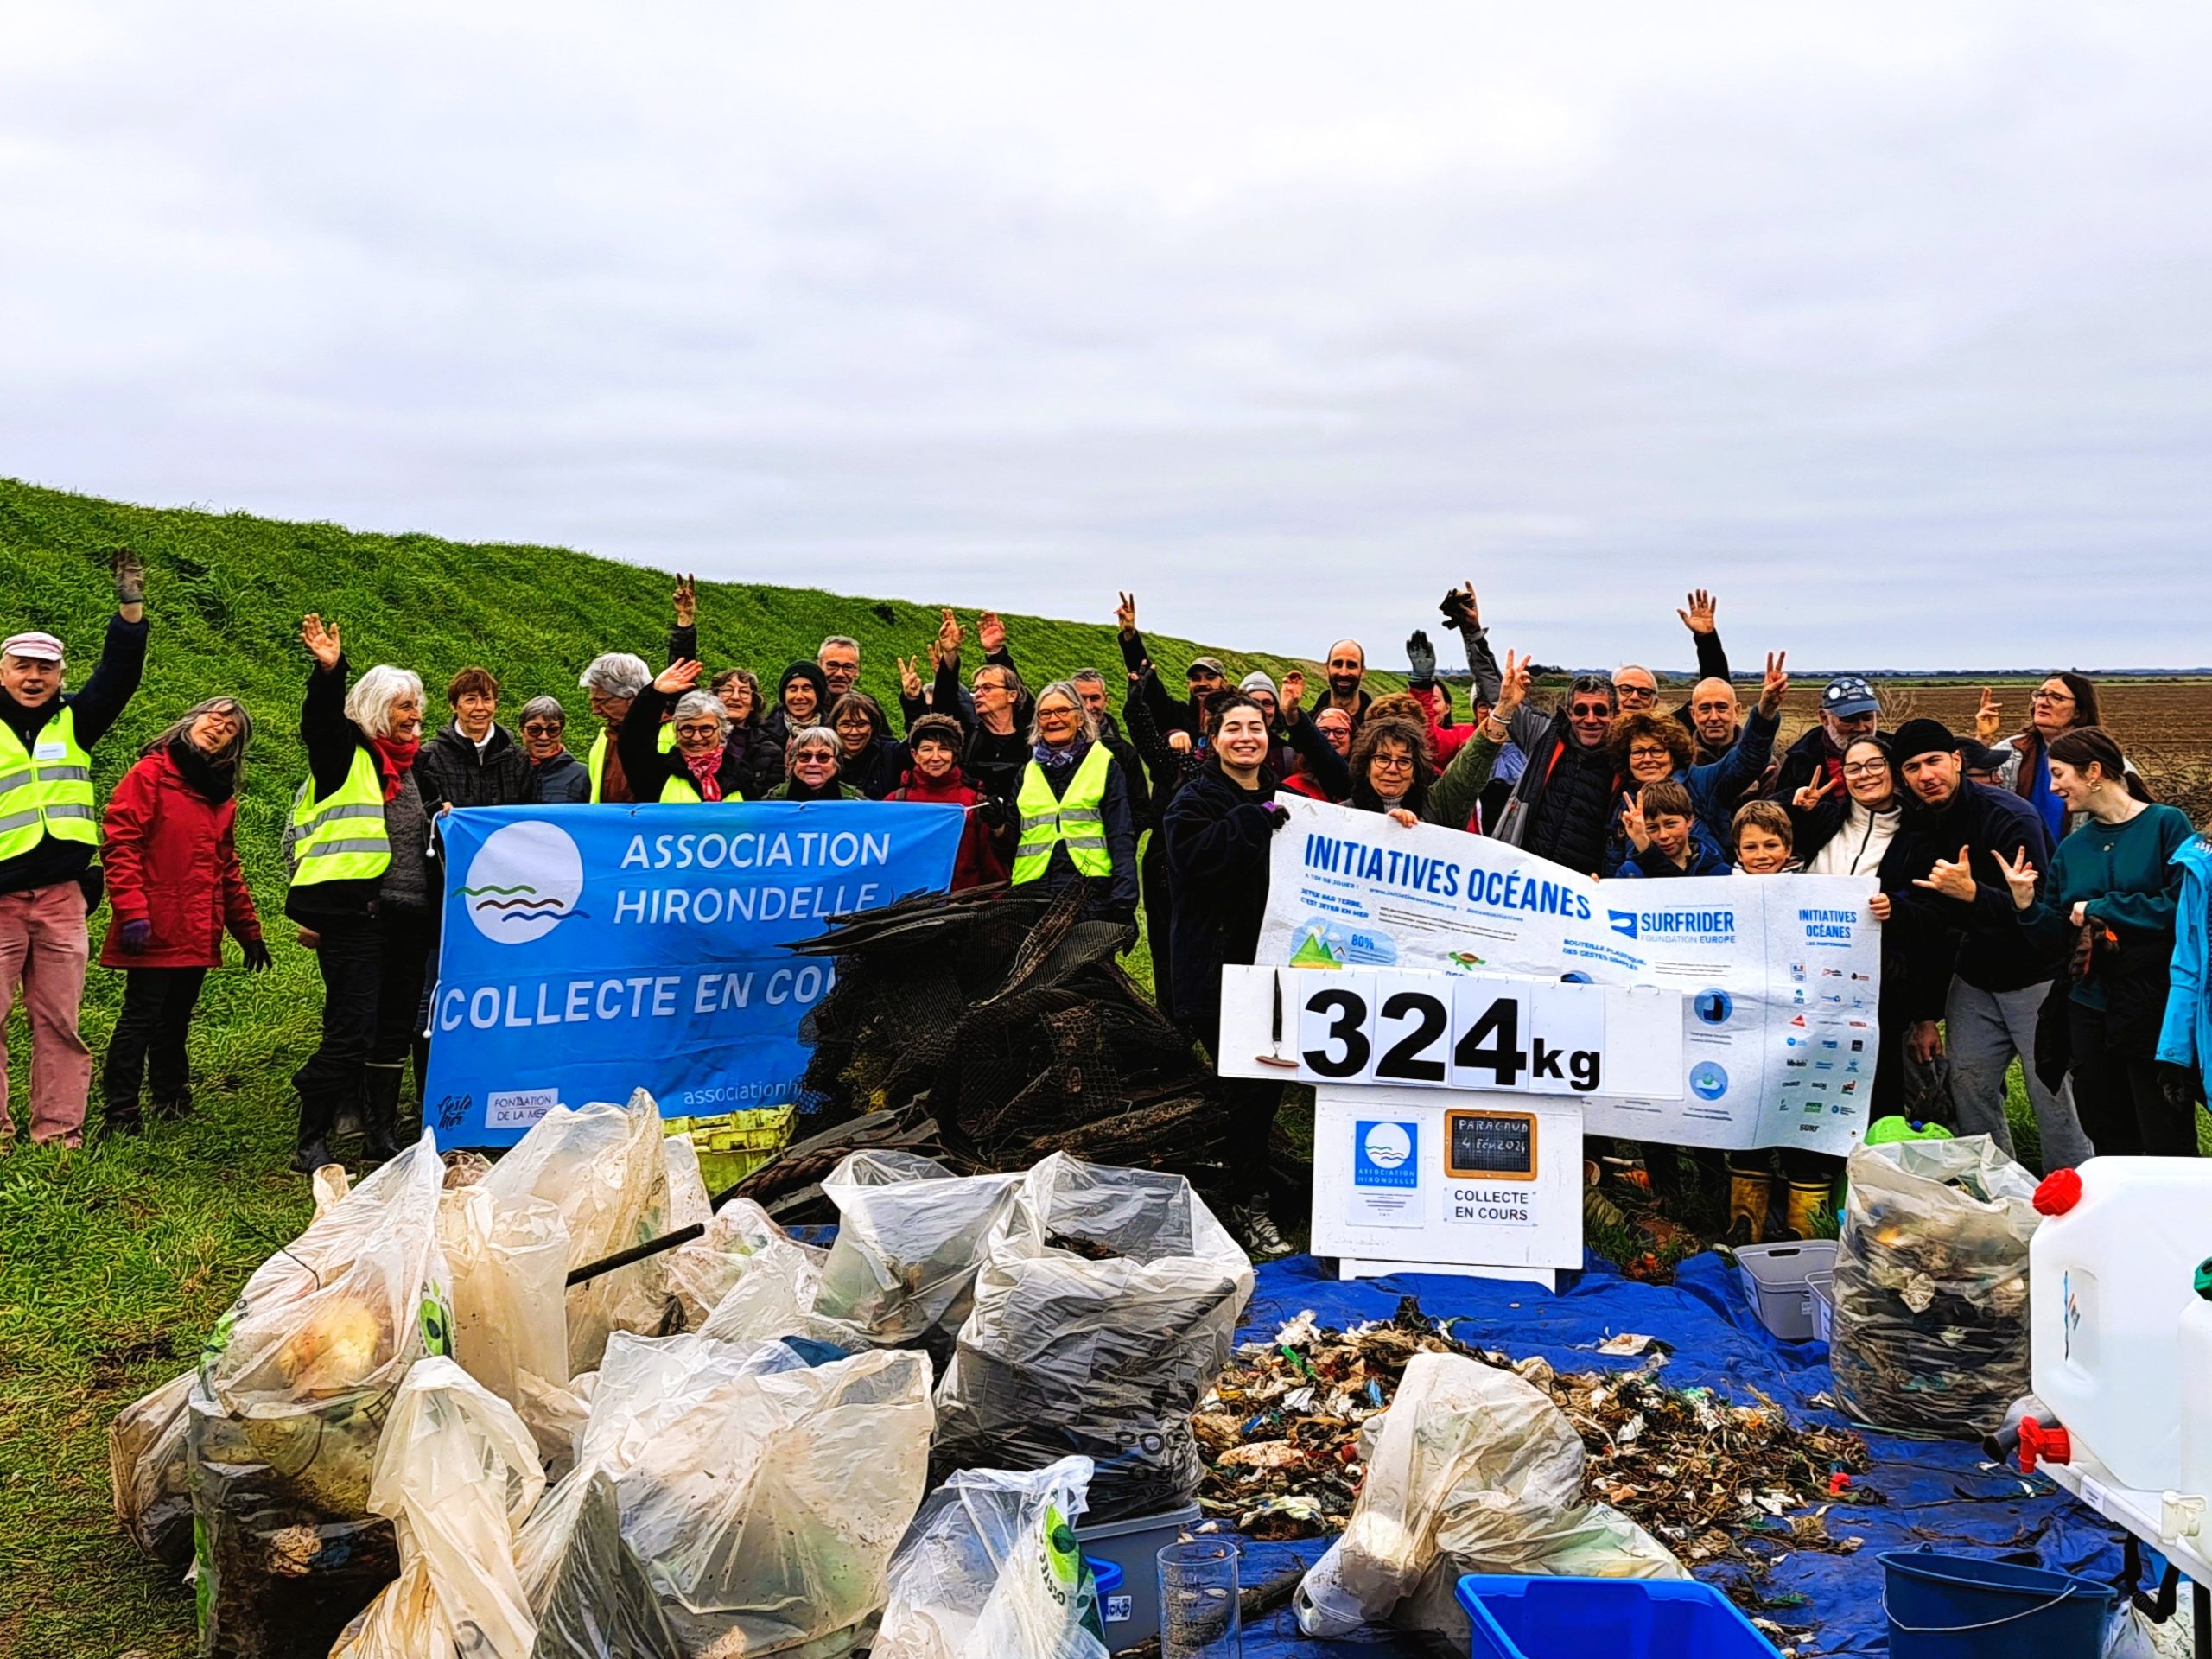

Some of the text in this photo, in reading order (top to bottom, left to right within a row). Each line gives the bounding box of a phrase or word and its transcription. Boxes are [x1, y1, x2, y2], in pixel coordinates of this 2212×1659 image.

[620, 830, 892, 869] ASSOCIATION
[1305, 833, 1460, 897] INITIATIVES
[1467, 868, 1592, 921] OCÉANES
[613, 882, 880, 925] HIRONDELLE
[1641, 912, 1735, 932] SURFRIDER
[1798, 909, 1857, 924] INITIATIVES
[1806, 922, 1851, 938] OCÉANES
[1351, 933, 1375, 950] 80%
[1563, 938, 1605, 951] BOUTEILLE
[1640, 934, 1736, 944] FOUNDATION EUROPE
[1580, 950, 1608, 961] GESTES
[1609, 957, 1639, 971] SIMPLES
[440, 976, 682, 1032] COLLECTE
[693, 971, 755, 1014] EN
[1302, 988, 1601, 1092] 324kg
[494, 1095, 552, 1108] FONDATION
[497, 1111, 510, 1122] DE
[513, 1110, 524, 1121] LA
[1461, 1137, 1471, 1149] 4
[1357, 1168, 1415, 1177] ASSOCIATION
[1357, 1176, 1415, 1185] HIRONDELLE
[1454, 1189, 1529, 1205] COLLECTE
[1455, 1206, 1529, 1221] EN COURS
